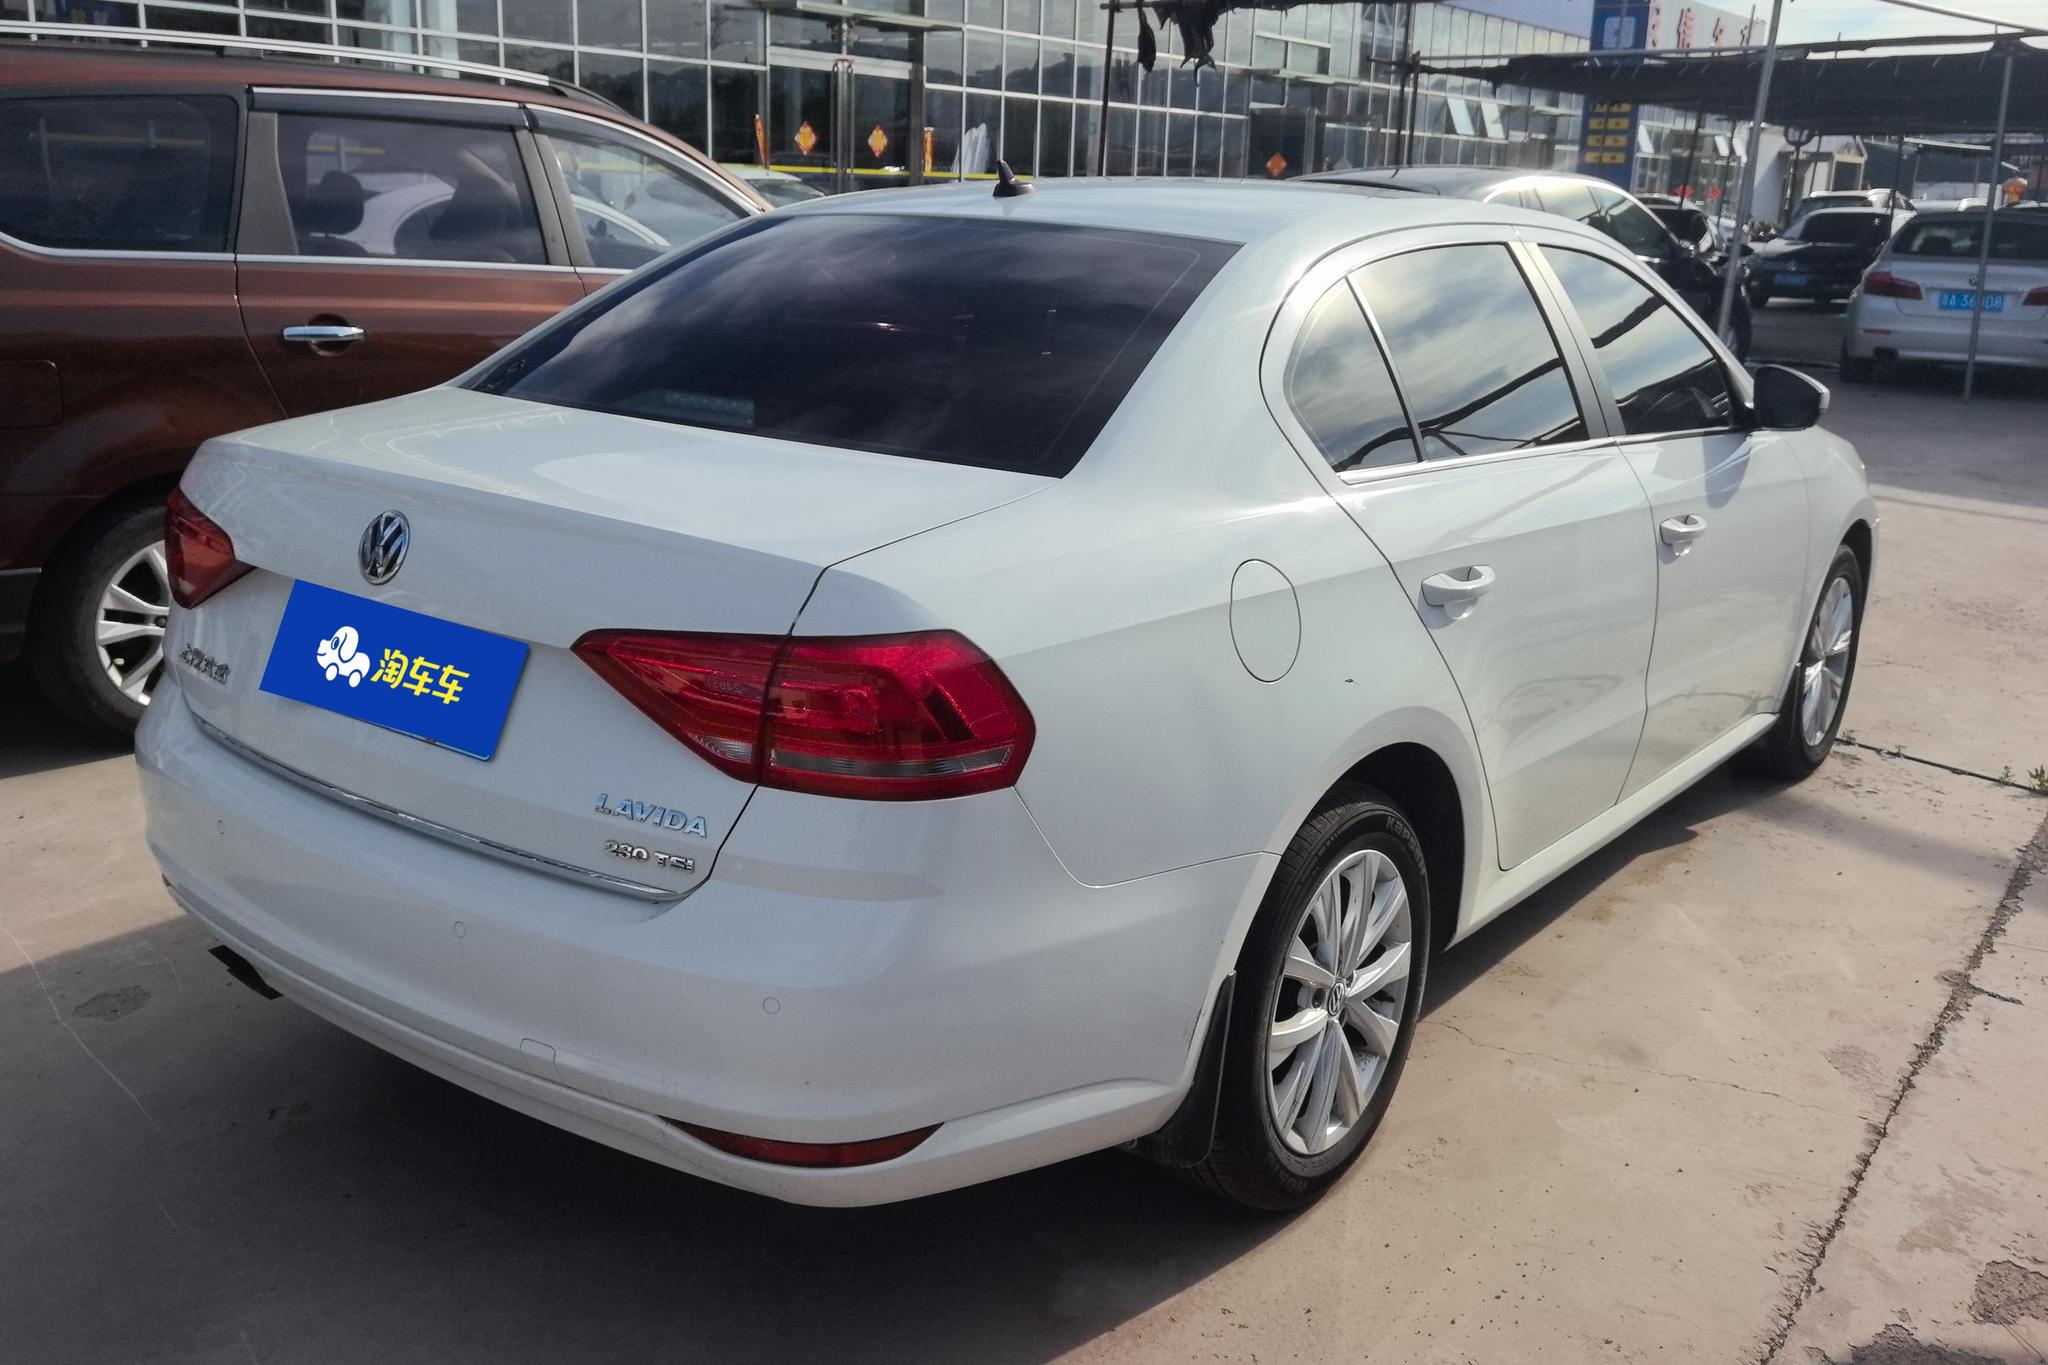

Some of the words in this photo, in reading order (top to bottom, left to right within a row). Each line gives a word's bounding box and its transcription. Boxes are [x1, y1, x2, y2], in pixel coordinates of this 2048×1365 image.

[594, 792, 707, 838] LAVIDA
[604, 839, 649, 862] 230
[654, 850, 696, 873] TSI
